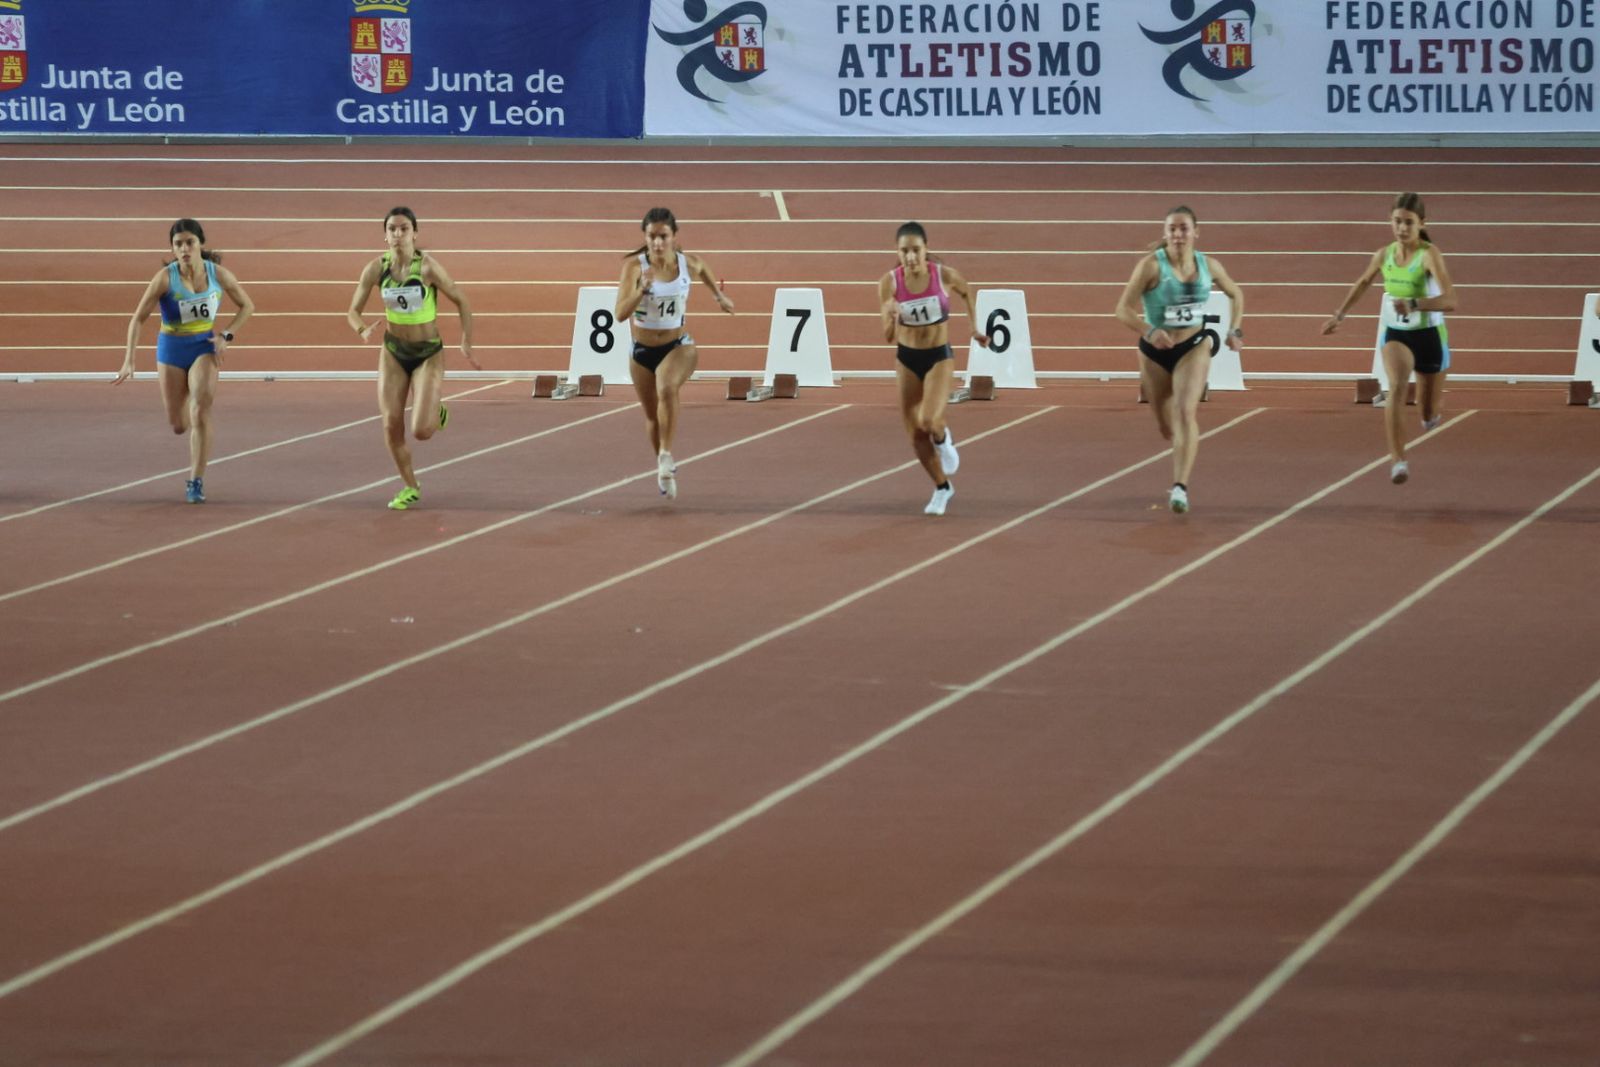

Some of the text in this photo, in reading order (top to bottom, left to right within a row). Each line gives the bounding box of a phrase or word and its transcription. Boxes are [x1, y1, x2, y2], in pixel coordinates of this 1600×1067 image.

[836, 0, 1101, 34] FEDERACIÓN DE
[1556, 0, 1595, 28] DE
[838, 41, 1101, 78] ATLETISMO
[1326, 37, 1594, 74] ATLETISMO
[41, 64, 184, 90] Junta de
[425, 67, 564, 93] Junta de
[839, 80, 1101, 116] DE CASTILLA Y LEÓN
[1327, 77, 1594, 113] DE CASTILLA Y LEÓN
[77, 102, 96, 129] y
[107, 97, 185, 122] León
[336, 98, 565, 132] Castilla y León
[190, 303, 209, 318] 16
[397, 294, 408, 310] 9
[657, 300, 676, 317] 14
[910, 305, 930, 322] 11
[589, 309, 615, 354] 8
[786, 308, 812, 352] 7
[985, 308, 1011, 354] 6
[1201, 314, 1221, 358] 5
